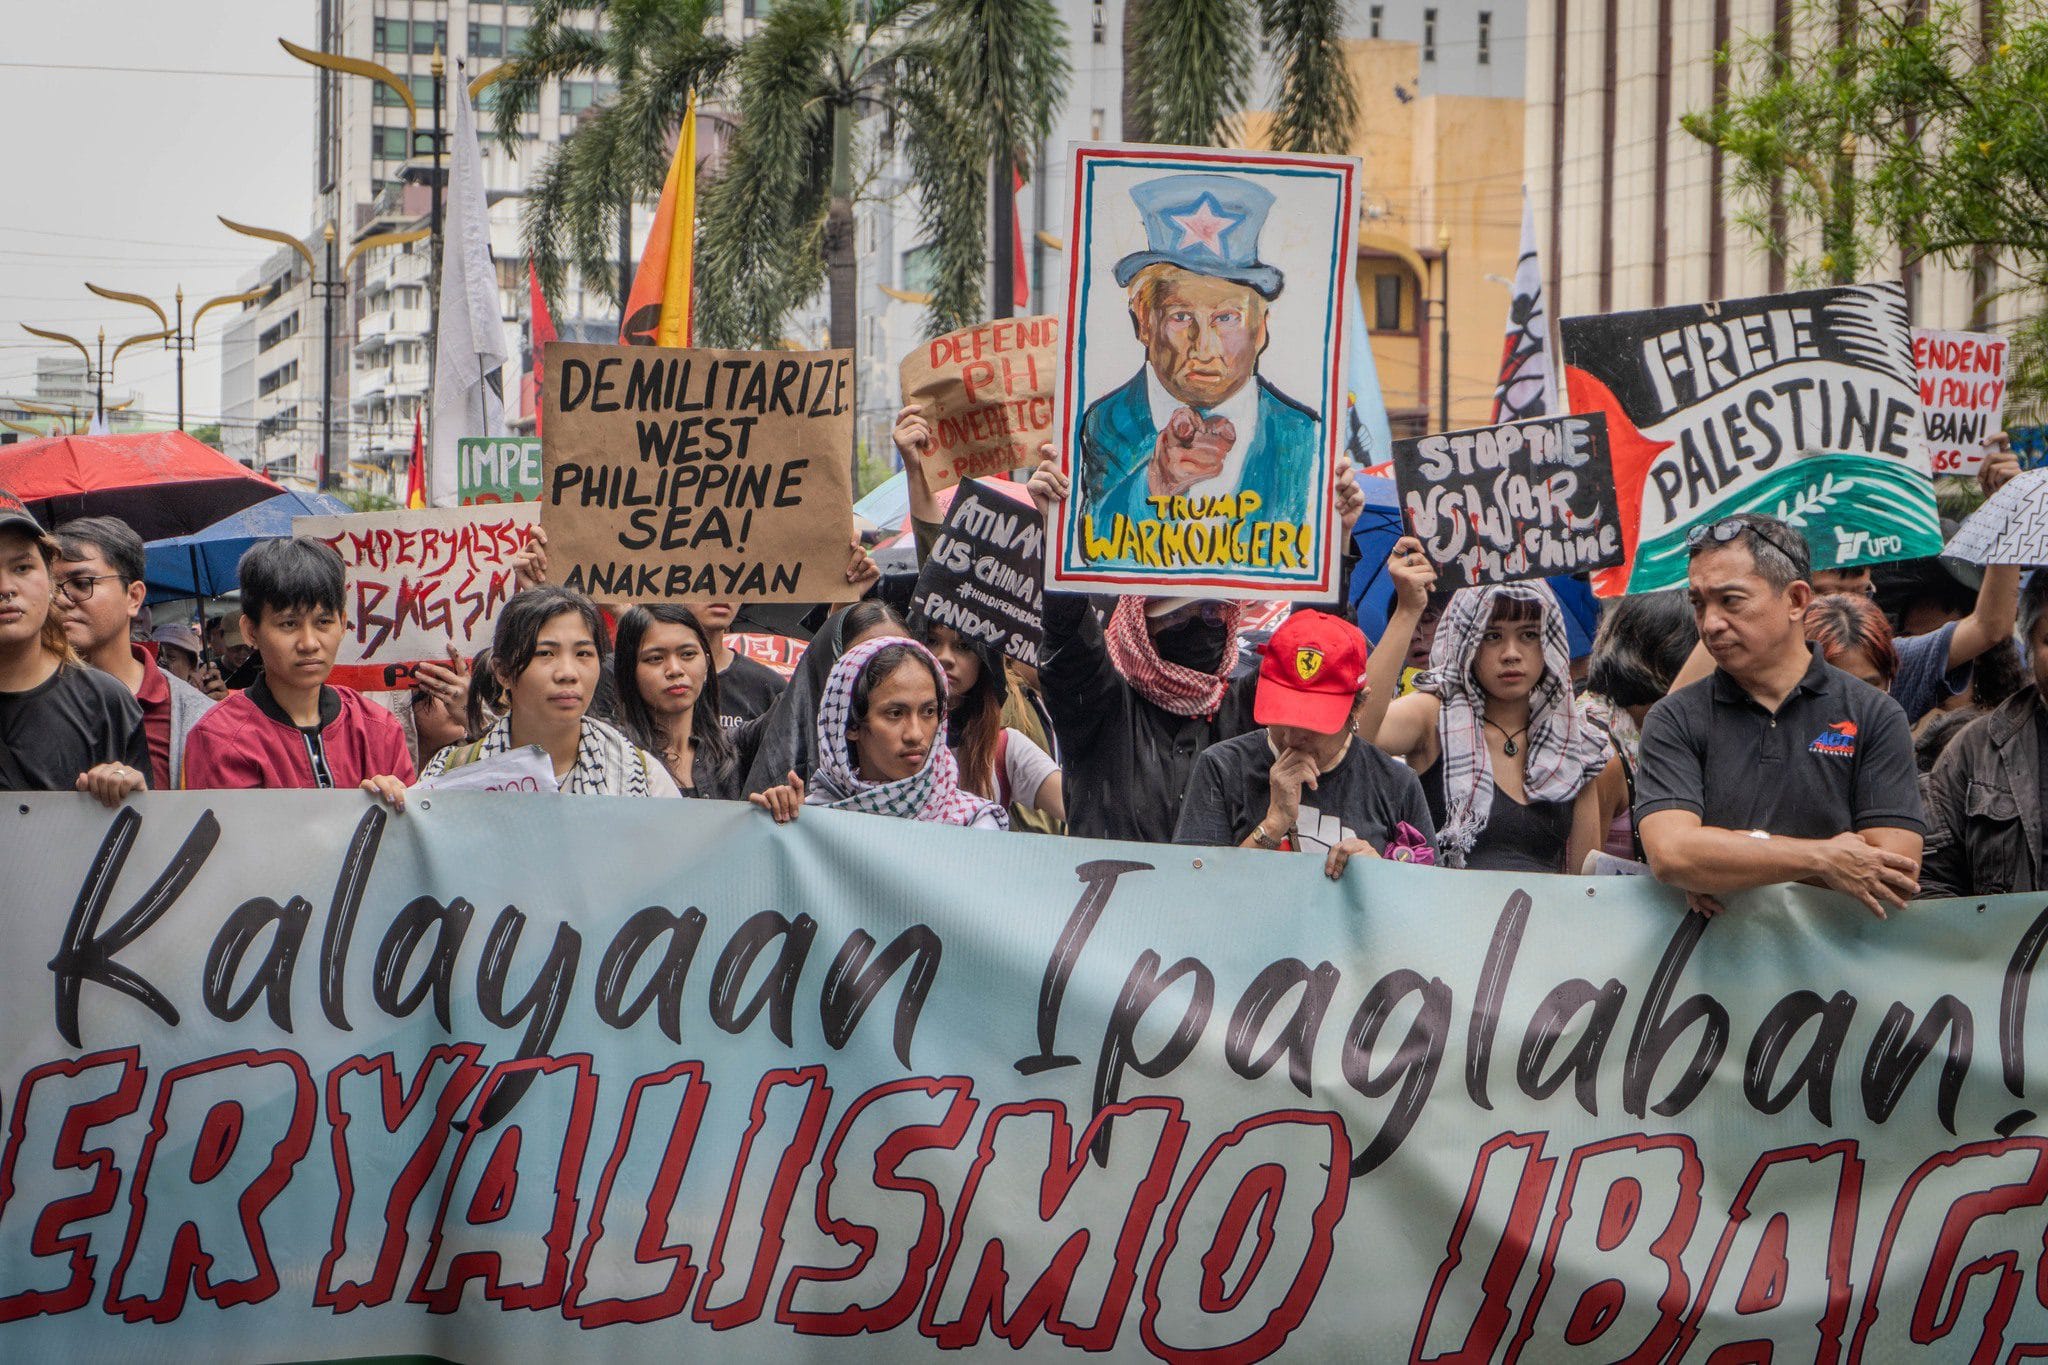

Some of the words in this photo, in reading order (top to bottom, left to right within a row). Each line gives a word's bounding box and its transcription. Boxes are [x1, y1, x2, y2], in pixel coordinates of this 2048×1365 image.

[930, 319, 1058, 369] DEFEND
[1642, 307, 1820, 413] FREE
[559, 357, 850, 418] DEMILITARIZE
[962, 354, 1039, 404] PH
[1938, 377, 2004, 412] POLICY
[636, 416, 758, 467] WEST
[1416, 425, 1524, 481] STOP
[1522, 419, 1591, 467] THE
[1651, 377, 1916, 525] PALESTINE
[552, 459, 809, 509] PHILIPPINE
[1146, 490, 1263, 521] TRUMP
[1463, 468, 1601, 551] WAR
[618, 506, 752, 553] SEA!
[1083, 512, 1312, 568] WARMONGER!
[1868, 535, 1902, 557] UPD
[564, 561, 802, 597] ANAKBAYAN
[48, 804, 942, 1132] Kalayaan
[1016, 859, 2048, 1177] Ipaglaban!
